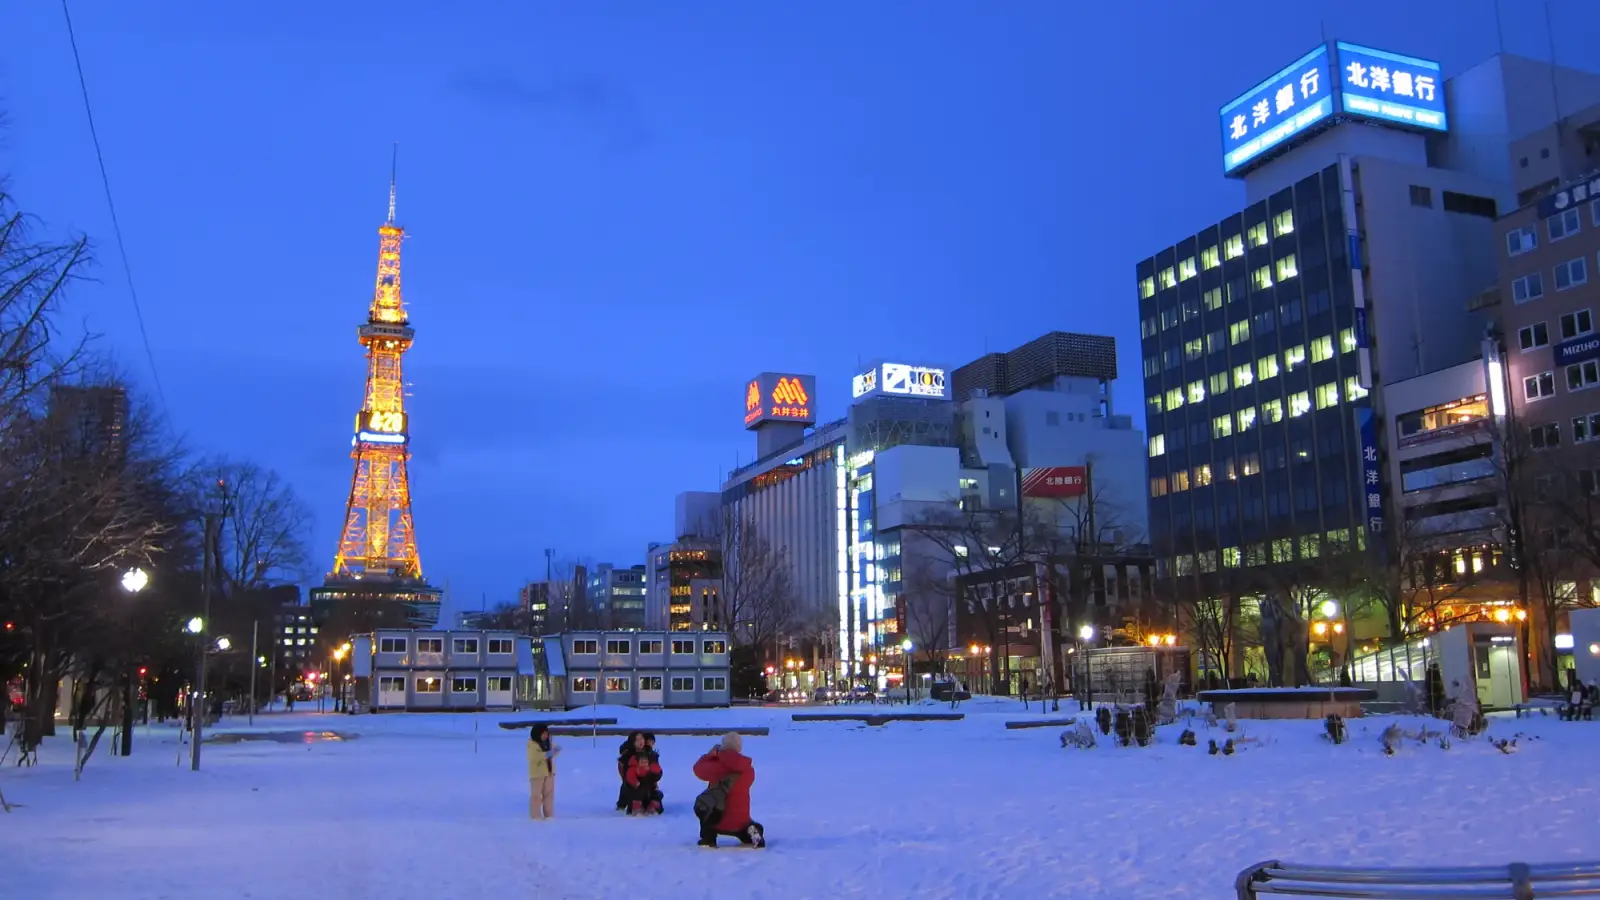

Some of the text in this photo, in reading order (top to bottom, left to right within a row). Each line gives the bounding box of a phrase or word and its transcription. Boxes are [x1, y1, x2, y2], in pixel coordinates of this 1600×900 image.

[1346, 61, 1436, 102] 北洋銀行
[1229, 67, 1320, 140] 北洋銀行
[1562, 339, 1600, 357] MIZUHO
[771, 406, 809, 419] 丸井今井
[1046, 476, 1082, 486] 北陸銀行
[1363, 445, 1384, 533] 北洋銀行
